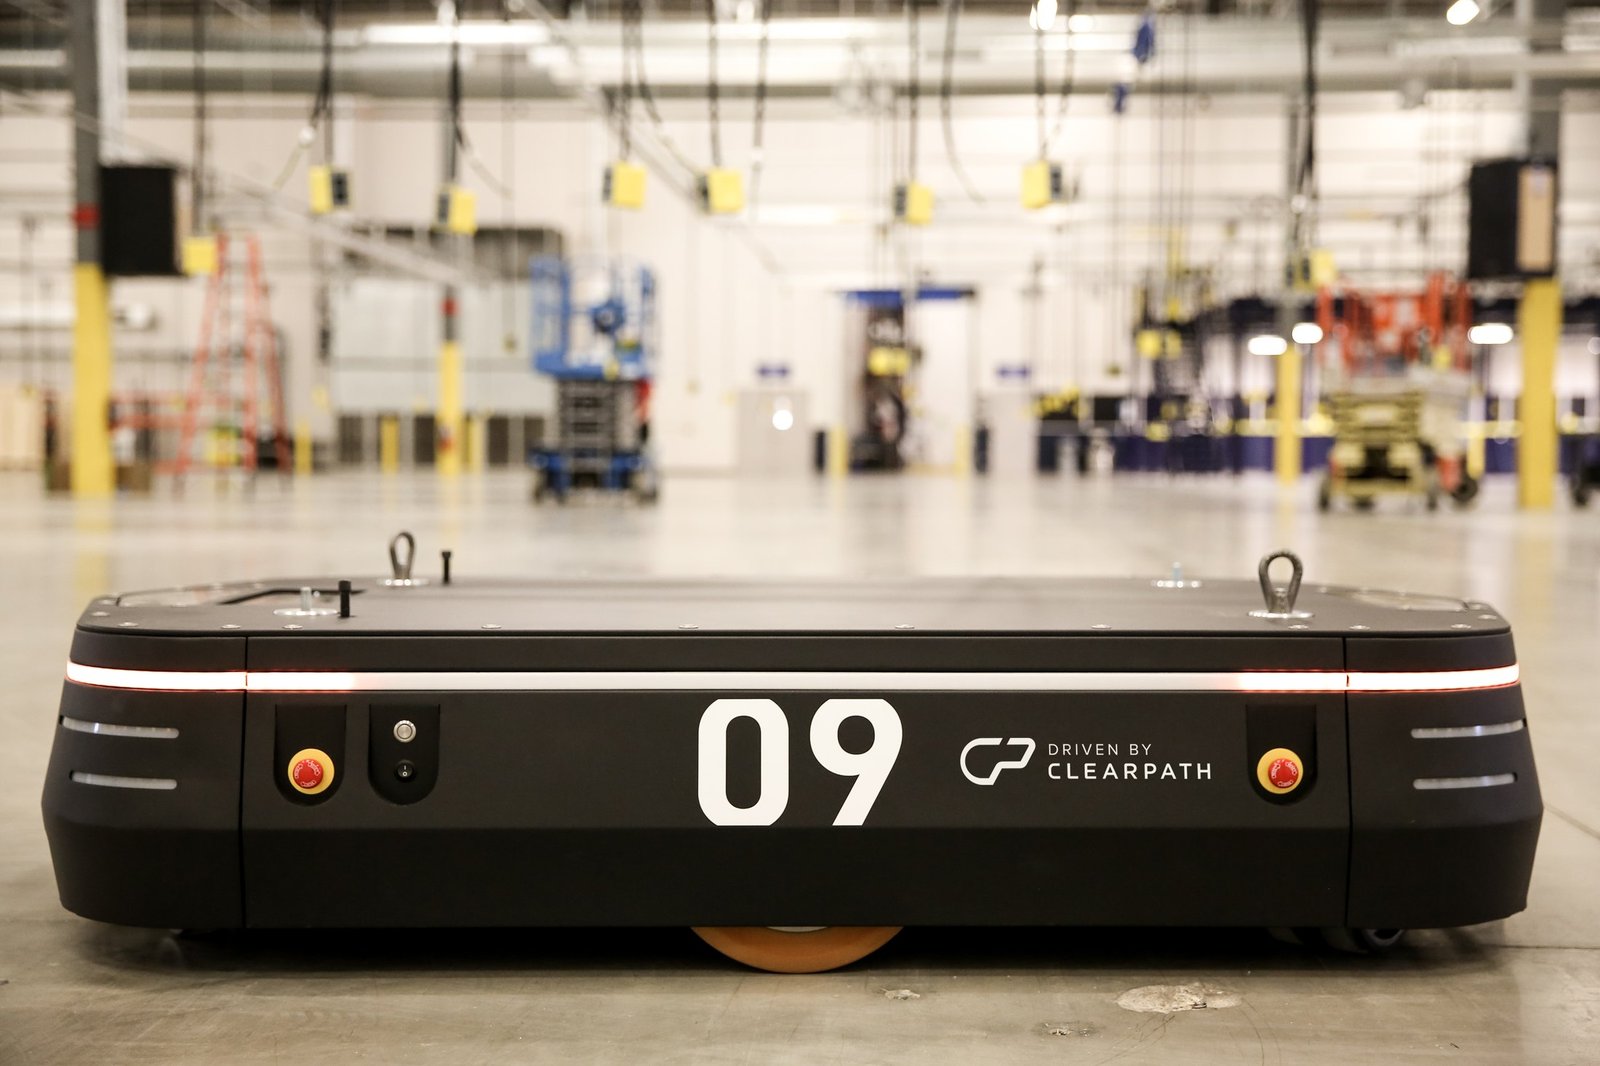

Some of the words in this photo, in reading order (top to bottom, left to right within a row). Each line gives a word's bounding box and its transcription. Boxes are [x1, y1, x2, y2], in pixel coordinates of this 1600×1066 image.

[1048, 743, 1119, 756] DRIVEN
[1129, 743, 1152, 756] BY
[698, 698, 903, 826] 09
[1048, 762, 1212, 780] CLEARPATH
